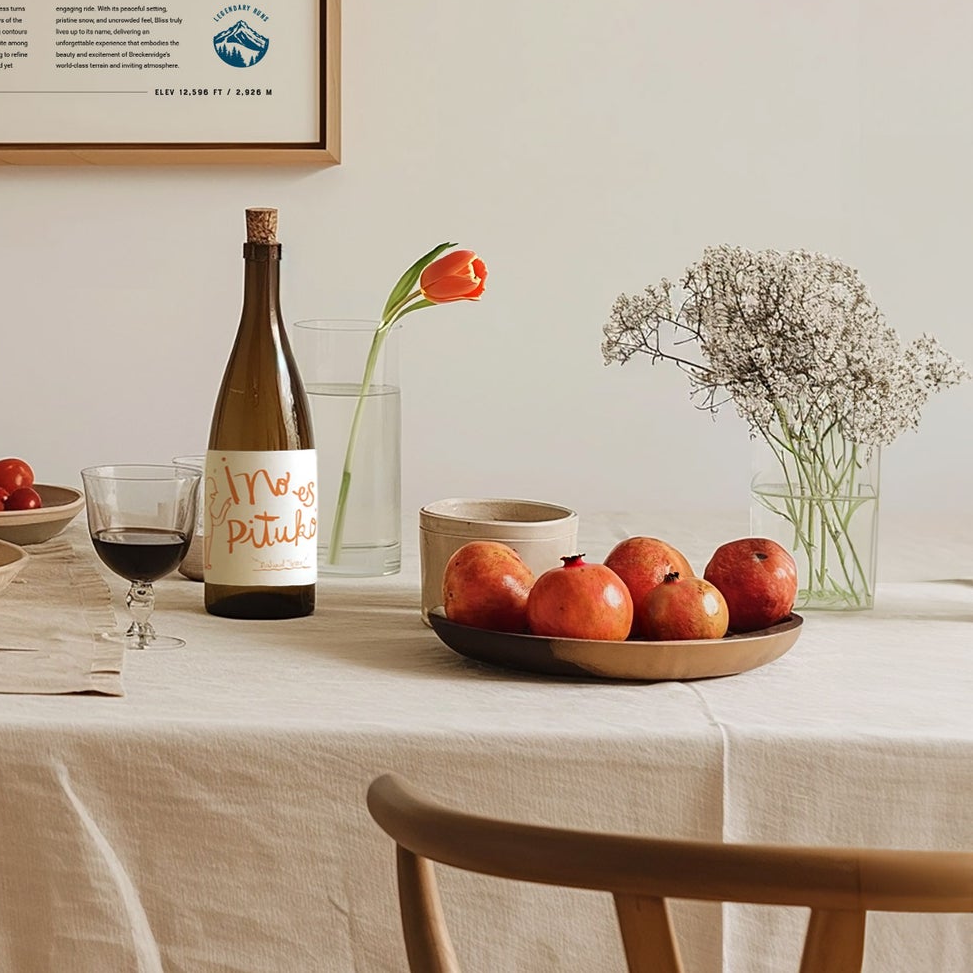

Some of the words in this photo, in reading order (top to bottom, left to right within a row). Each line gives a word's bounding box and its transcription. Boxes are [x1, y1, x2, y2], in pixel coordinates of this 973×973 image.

[55, 5, 83, 14] engaging
[119, 5, 146, 14] peaceful
[146, 5, 168, 14] setting,
[213, 4, 251, 22] LEGENDARY
[55, 17, 78, 25] pristine
[169, 17, 183, 25] truly
[113, 28, 142, 37] delivering
[55, 39, 95, 48] unforgettable
[95, 39, 127, 48] experience
[55, 51, 76, 60] beauty
[3, 62, 13, 71] yet
[121, 62, 143, 71] inviting
[143, 62, 180, 71] atmosphere.
[154, 88, 175, 96] ELEV
[213, 88, 223, 96] FT
[265, 88, 273, 96] M
[292, 481, 315, 507] es
